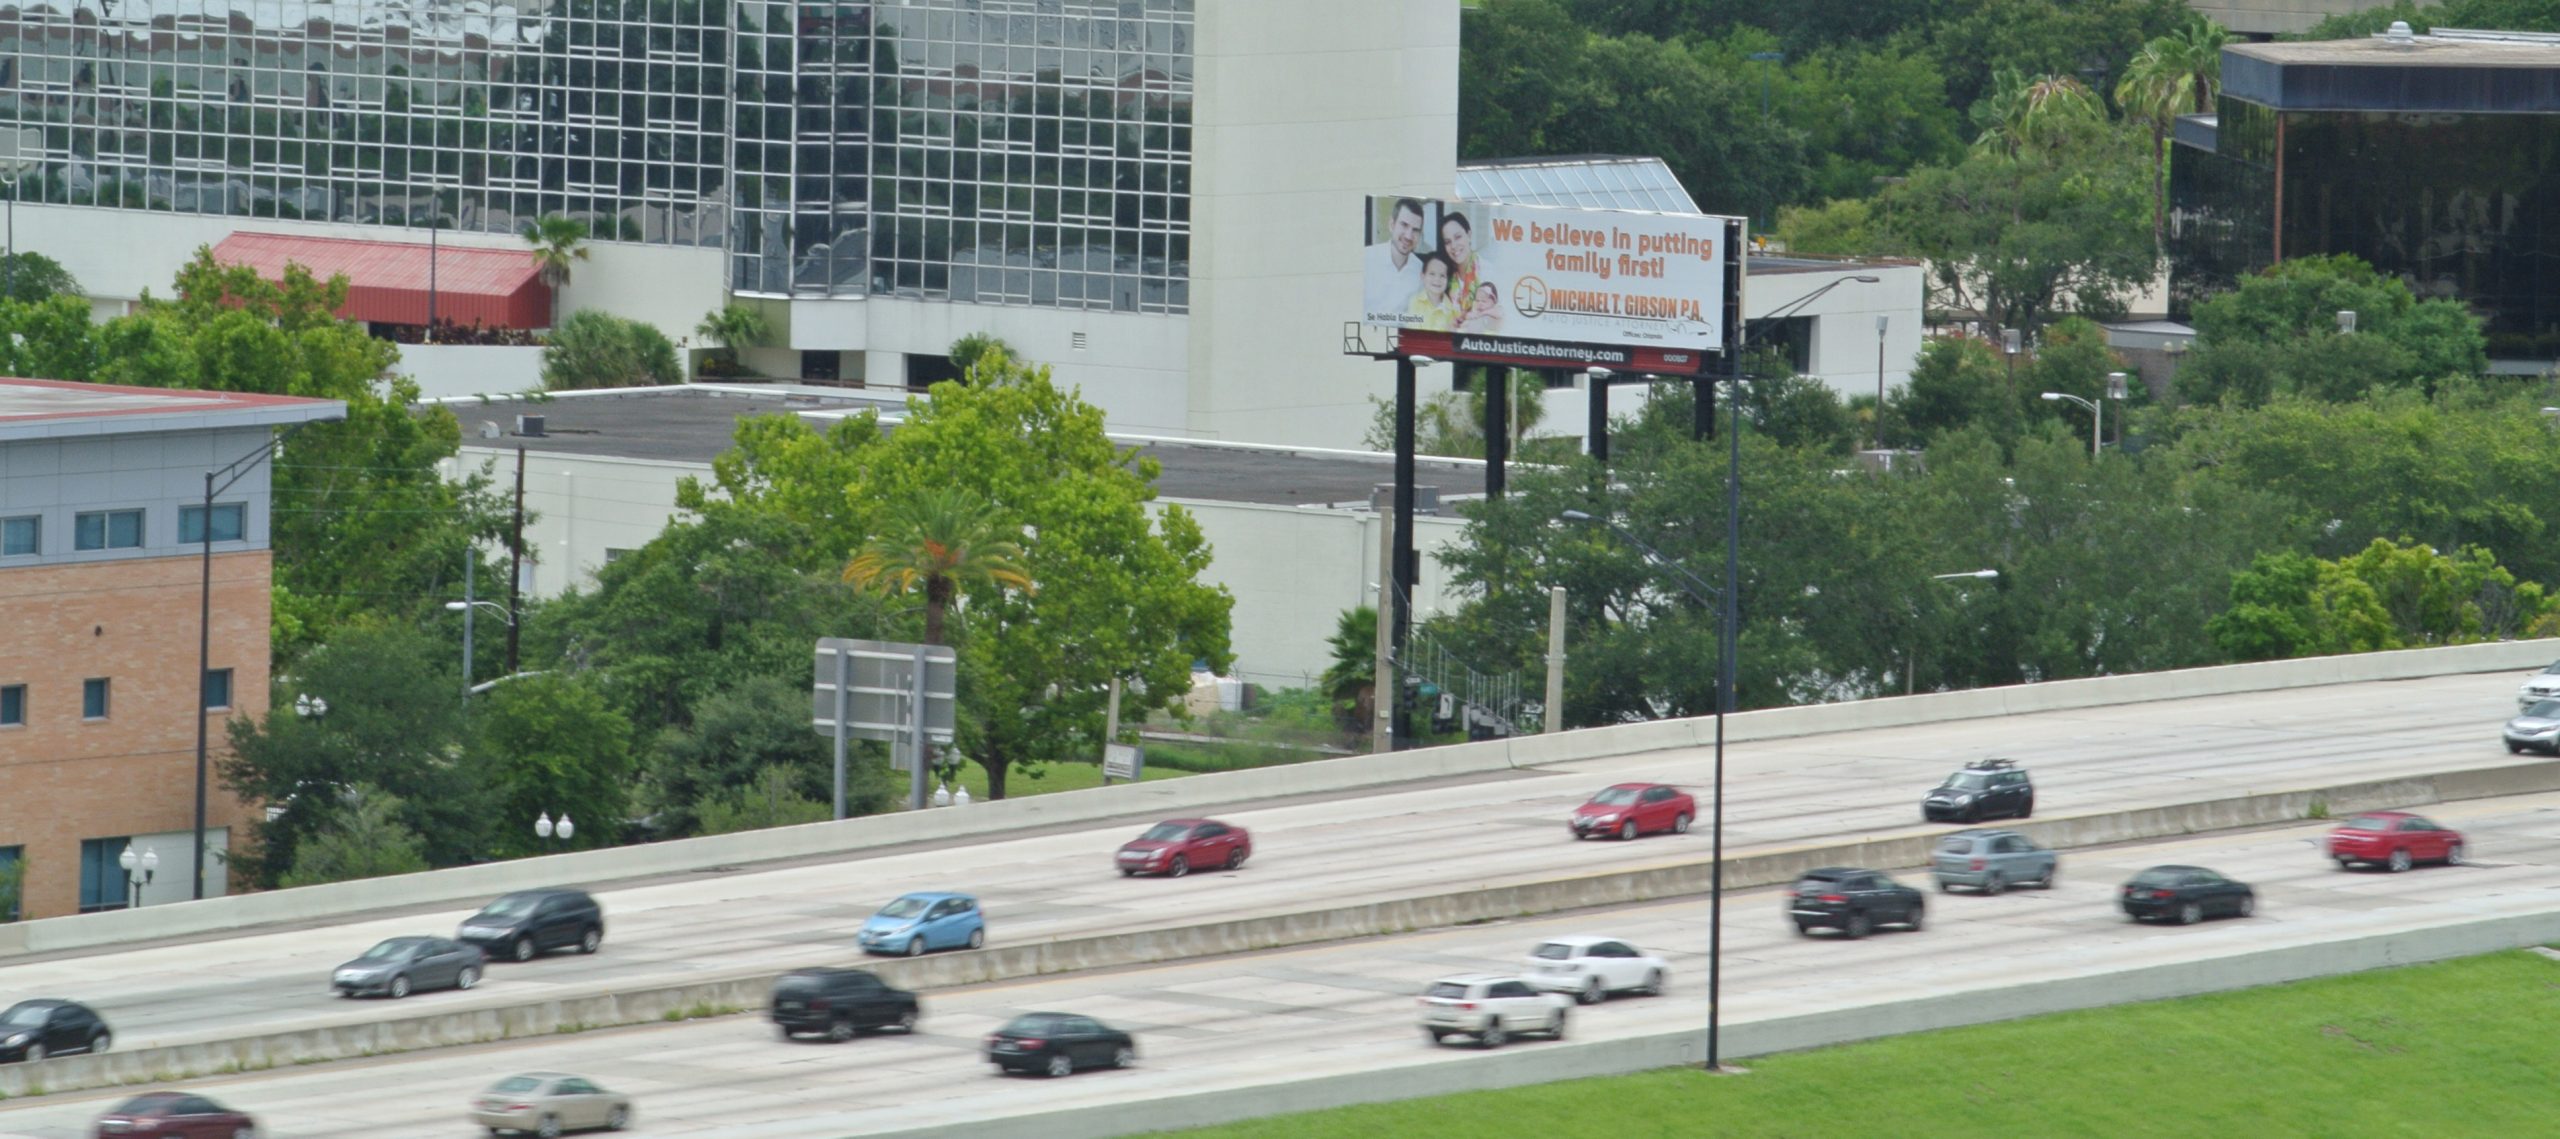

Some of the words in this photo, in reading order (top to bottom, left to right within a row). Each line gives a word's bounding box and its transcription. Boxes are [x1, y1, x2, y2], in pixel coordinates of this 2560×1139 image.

[1493, 218, 1524, 242] We
[1531, 221, 1605, 248] believe
[1613, 226, 1631, 249] in
[1638, 232, 1713, 261] putting
[1545, 248, 1611, 279] family
[1618, 253, 1665, 279] first!
[1367, 312, 1375, 321] Se
[1377, 312, 1397, 321] Habla
[1550, 289, 1610, 314] MICHAEL
[1612, 293, 1621, 314] T.
[1624, 294, 1677, 319] GIBSON
[1680, 299, 1704, 322] P.A.
[1543, 314, 1569, 324] AUTO
[1572, 316, 1608, 328] JUSTICE
[1460, 337, 1624, 363] AutoJusticeAttorney.com
